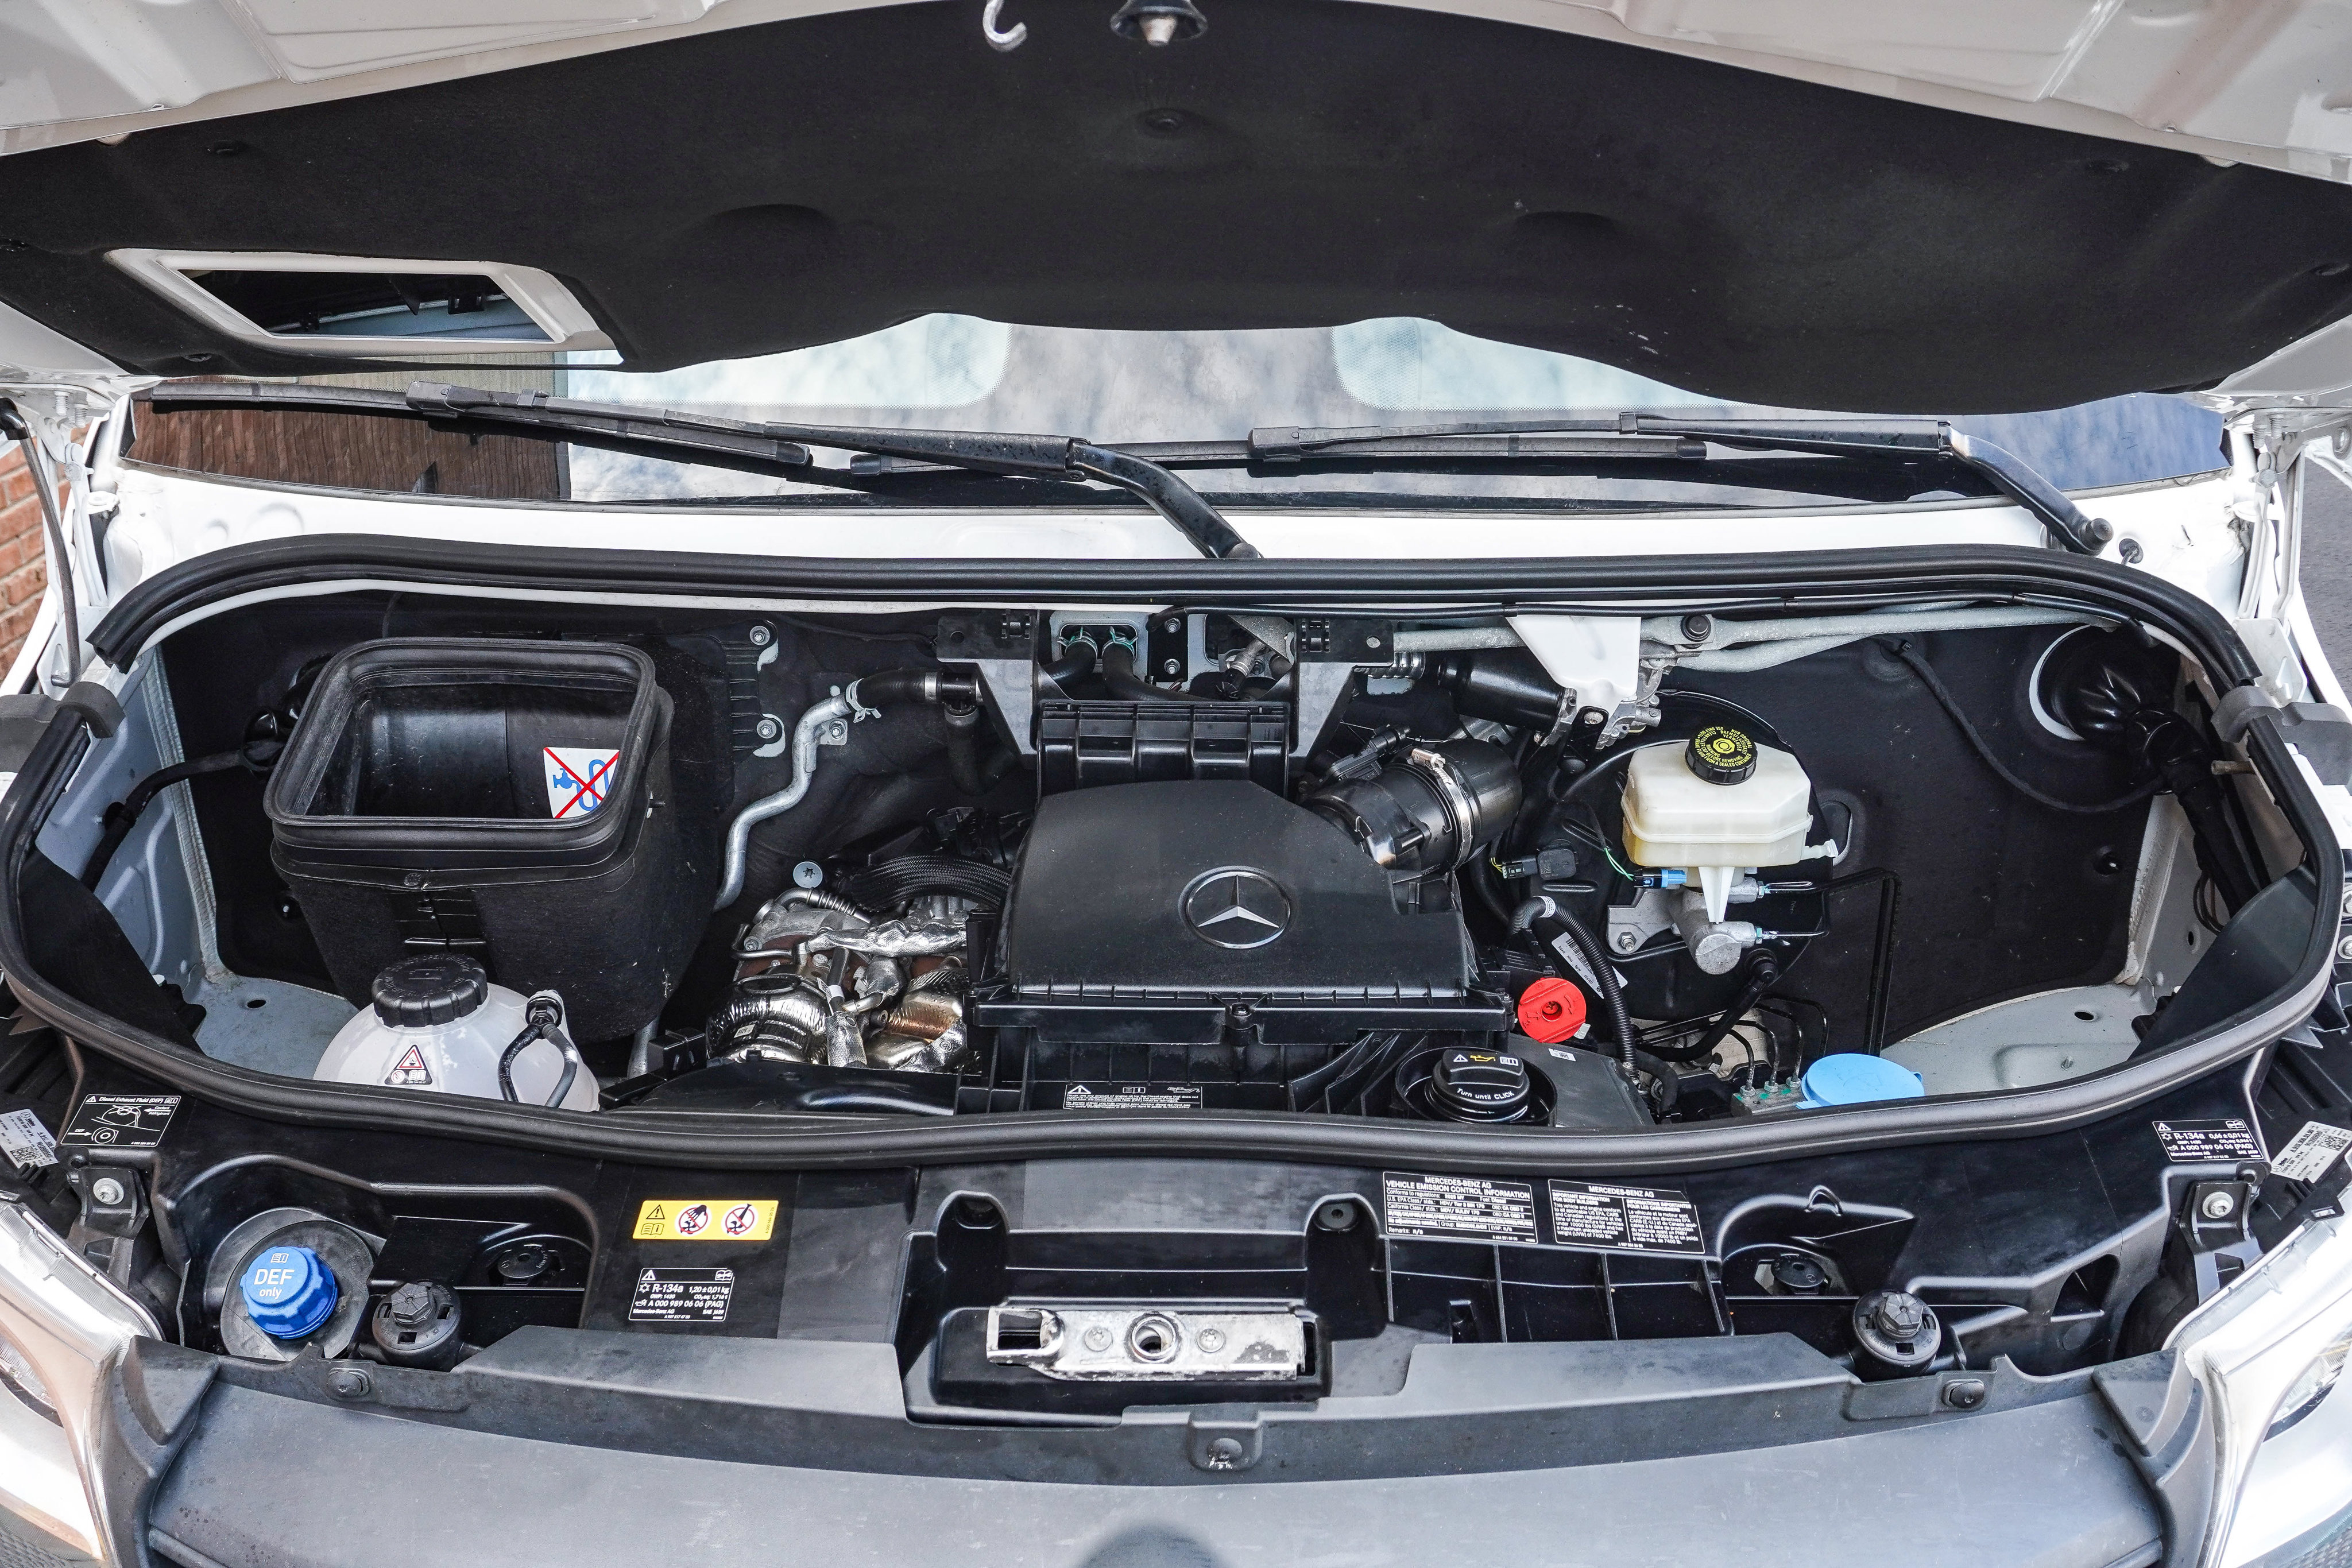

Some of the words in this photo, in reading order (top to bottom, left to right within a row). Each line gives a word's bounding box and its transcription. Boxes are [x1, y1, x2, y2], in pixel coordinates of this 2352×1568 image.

[1723, 734, 1742, 752] VERWENDEN
[1740, 734, 1753, 748] ORIGINAL
[1706, 744, 1720, 757] WARNING
[1696, 749, 1705, 757] FLUID
[1704, 756, 1715, 764] FROM
[1735, 753, 1751, 766] CONTAINER
[1706, 753, 1721, 762] BEFORE
[1457, 1088, 1472, 1097] Turn
[1494, 1091, 1514, 1099] CLICK
[1425, 1176, 1480, 1188] MERCEDES-BENZ
[1386, 1180, 1415, 1189] VEHICLE
[1416, 1183, 1449, 1192] EMISSION
[1450, 1186, 1483, 1195] CONTROL
[1484, 1189, 1530, 1199] INFORMATION
[1588, 1186, 1643, 1197] MERCEDES-BENZ
[254, 1269, 295, 1285] DEF
[260, 1287, 283, 1300] only
[652, 1284, 684, 1292] R-134a
